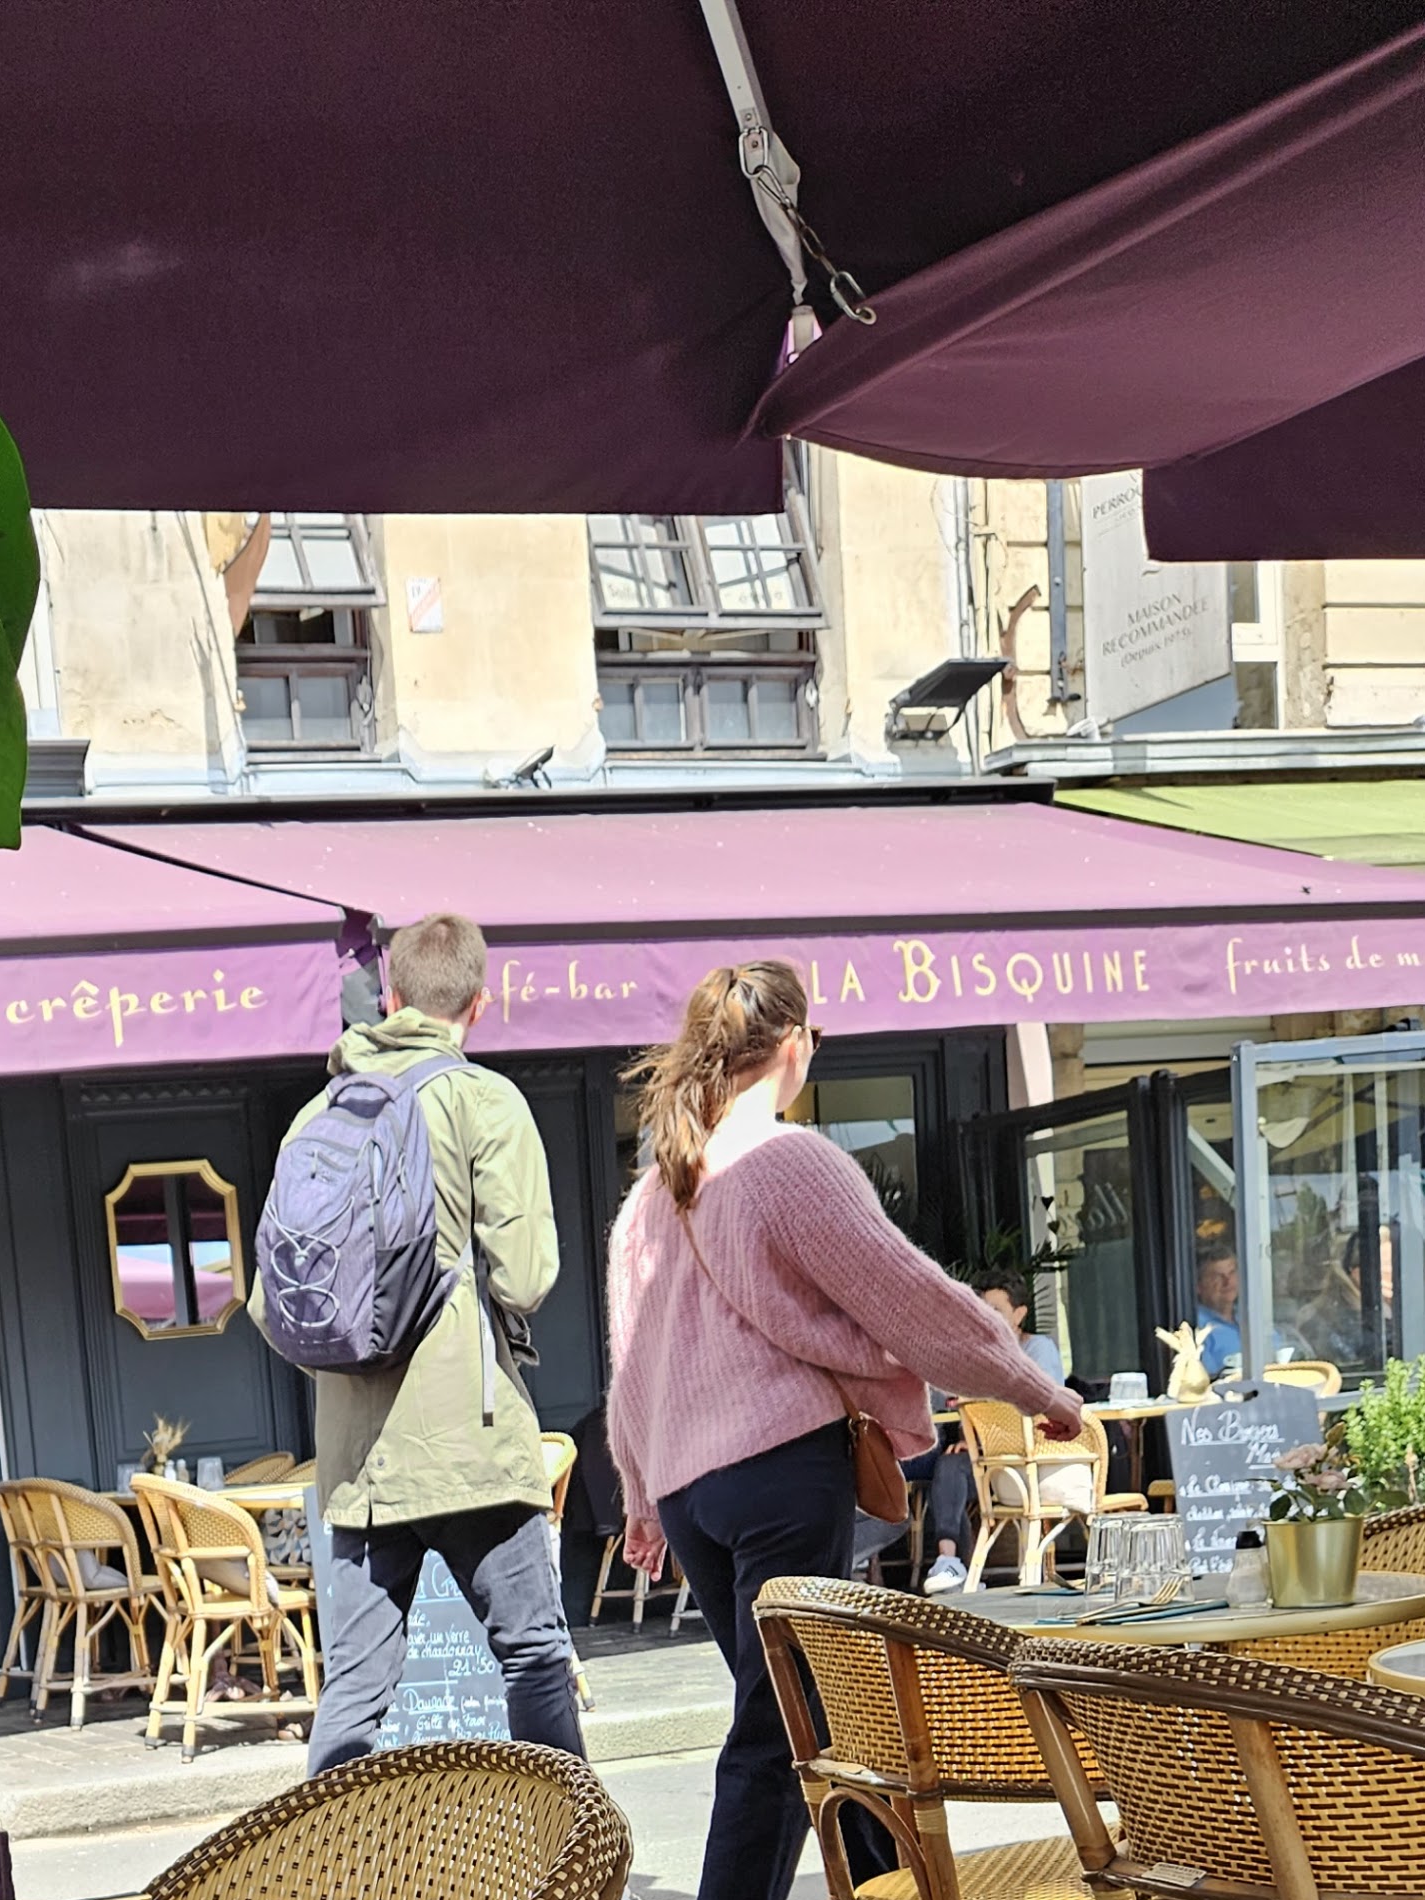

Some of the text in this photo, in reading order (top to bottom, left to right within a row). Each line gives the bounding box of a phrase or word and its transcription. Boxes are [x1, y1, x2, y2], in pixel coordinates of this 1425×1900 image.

[1127, 593, 1182, 626] MAISON
[811, 940, 1150, 1004] LA BISQUINE
[1225, 937, 1330, 995] fruits
[1346, 934, 1385, 970] de
[5, 969, 268, 1048] crêperie
